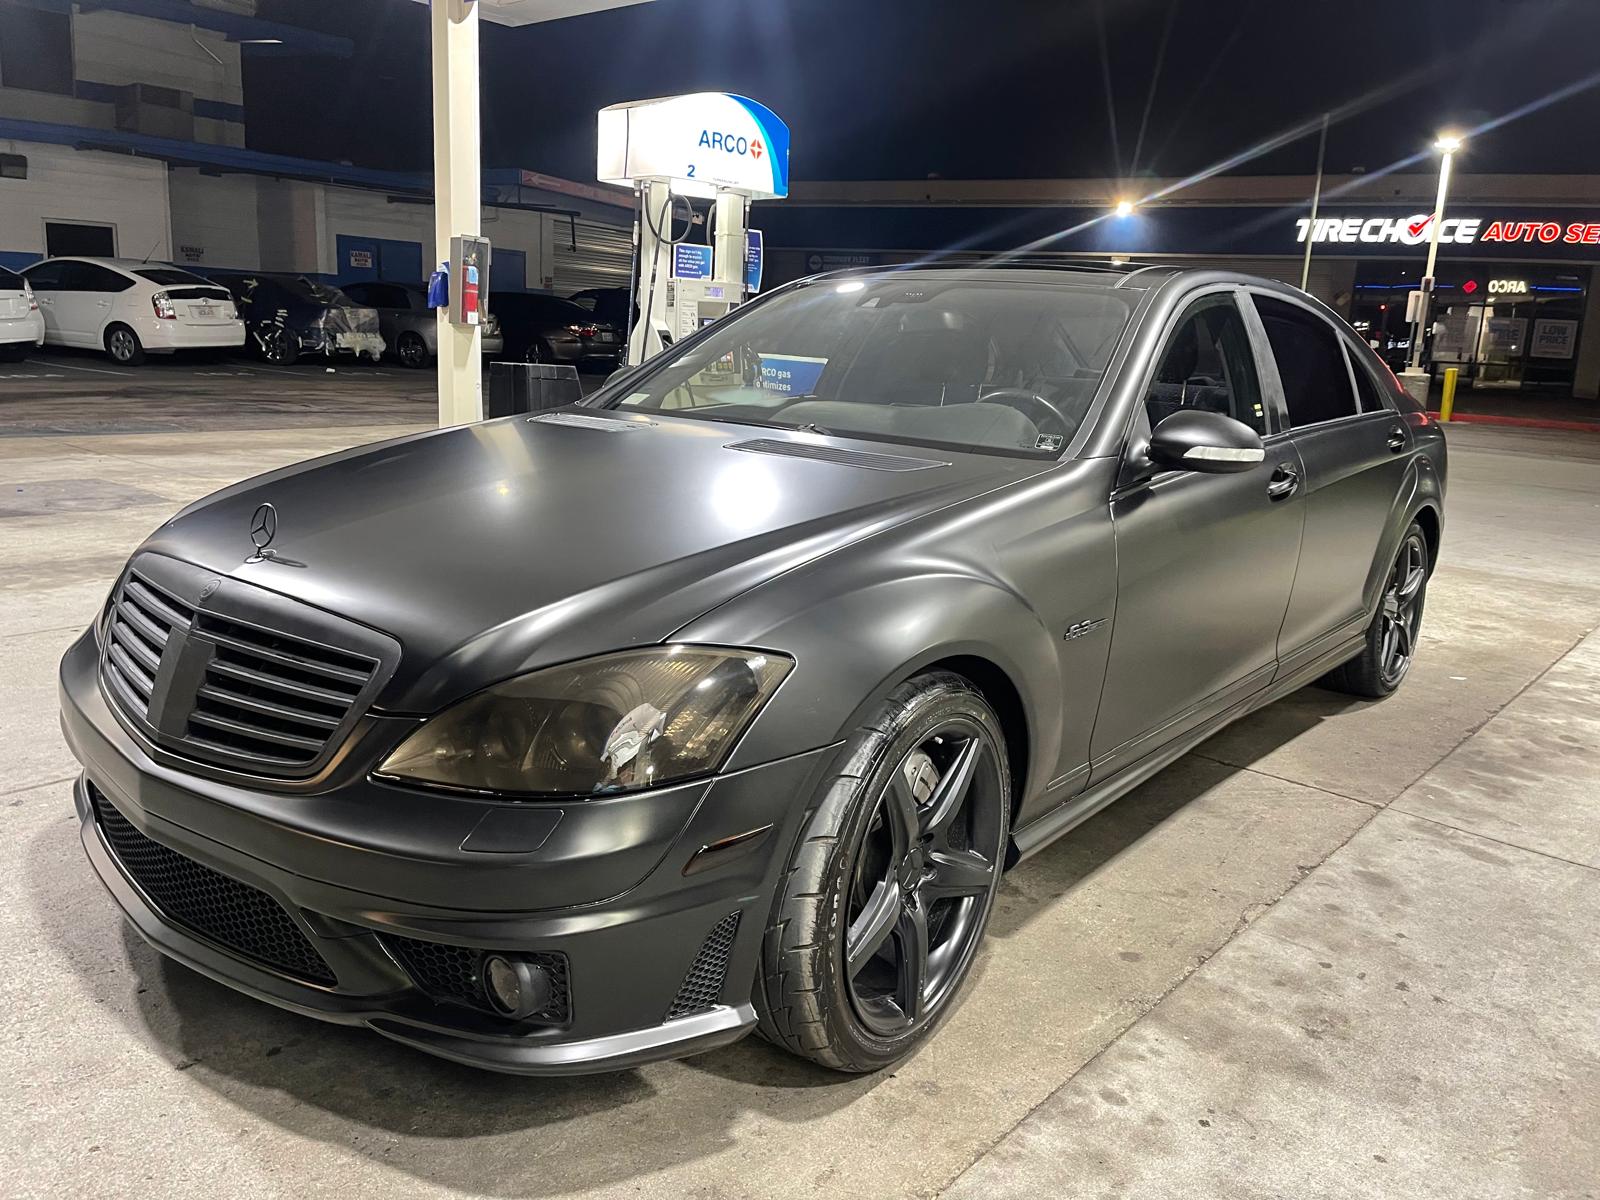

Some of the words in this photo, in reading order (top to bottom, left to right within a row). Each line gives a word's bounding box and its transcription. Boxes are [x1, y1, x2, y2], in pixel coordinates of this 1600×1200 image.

[698, 129, 747, 156] ARCO
[686, 164, 696, 178] 2
[1480, 221, 1561, 243] AUTO
[1563, 223, 1600, 244] SE
[1542, 324, 1568, 335] LOW
[1538, 335, 1569, 345] PRICE
[760, 367, 777, 378] RCO
[777, 370, 792, 380] gas
[755, 380, 792, 392] otimizes
